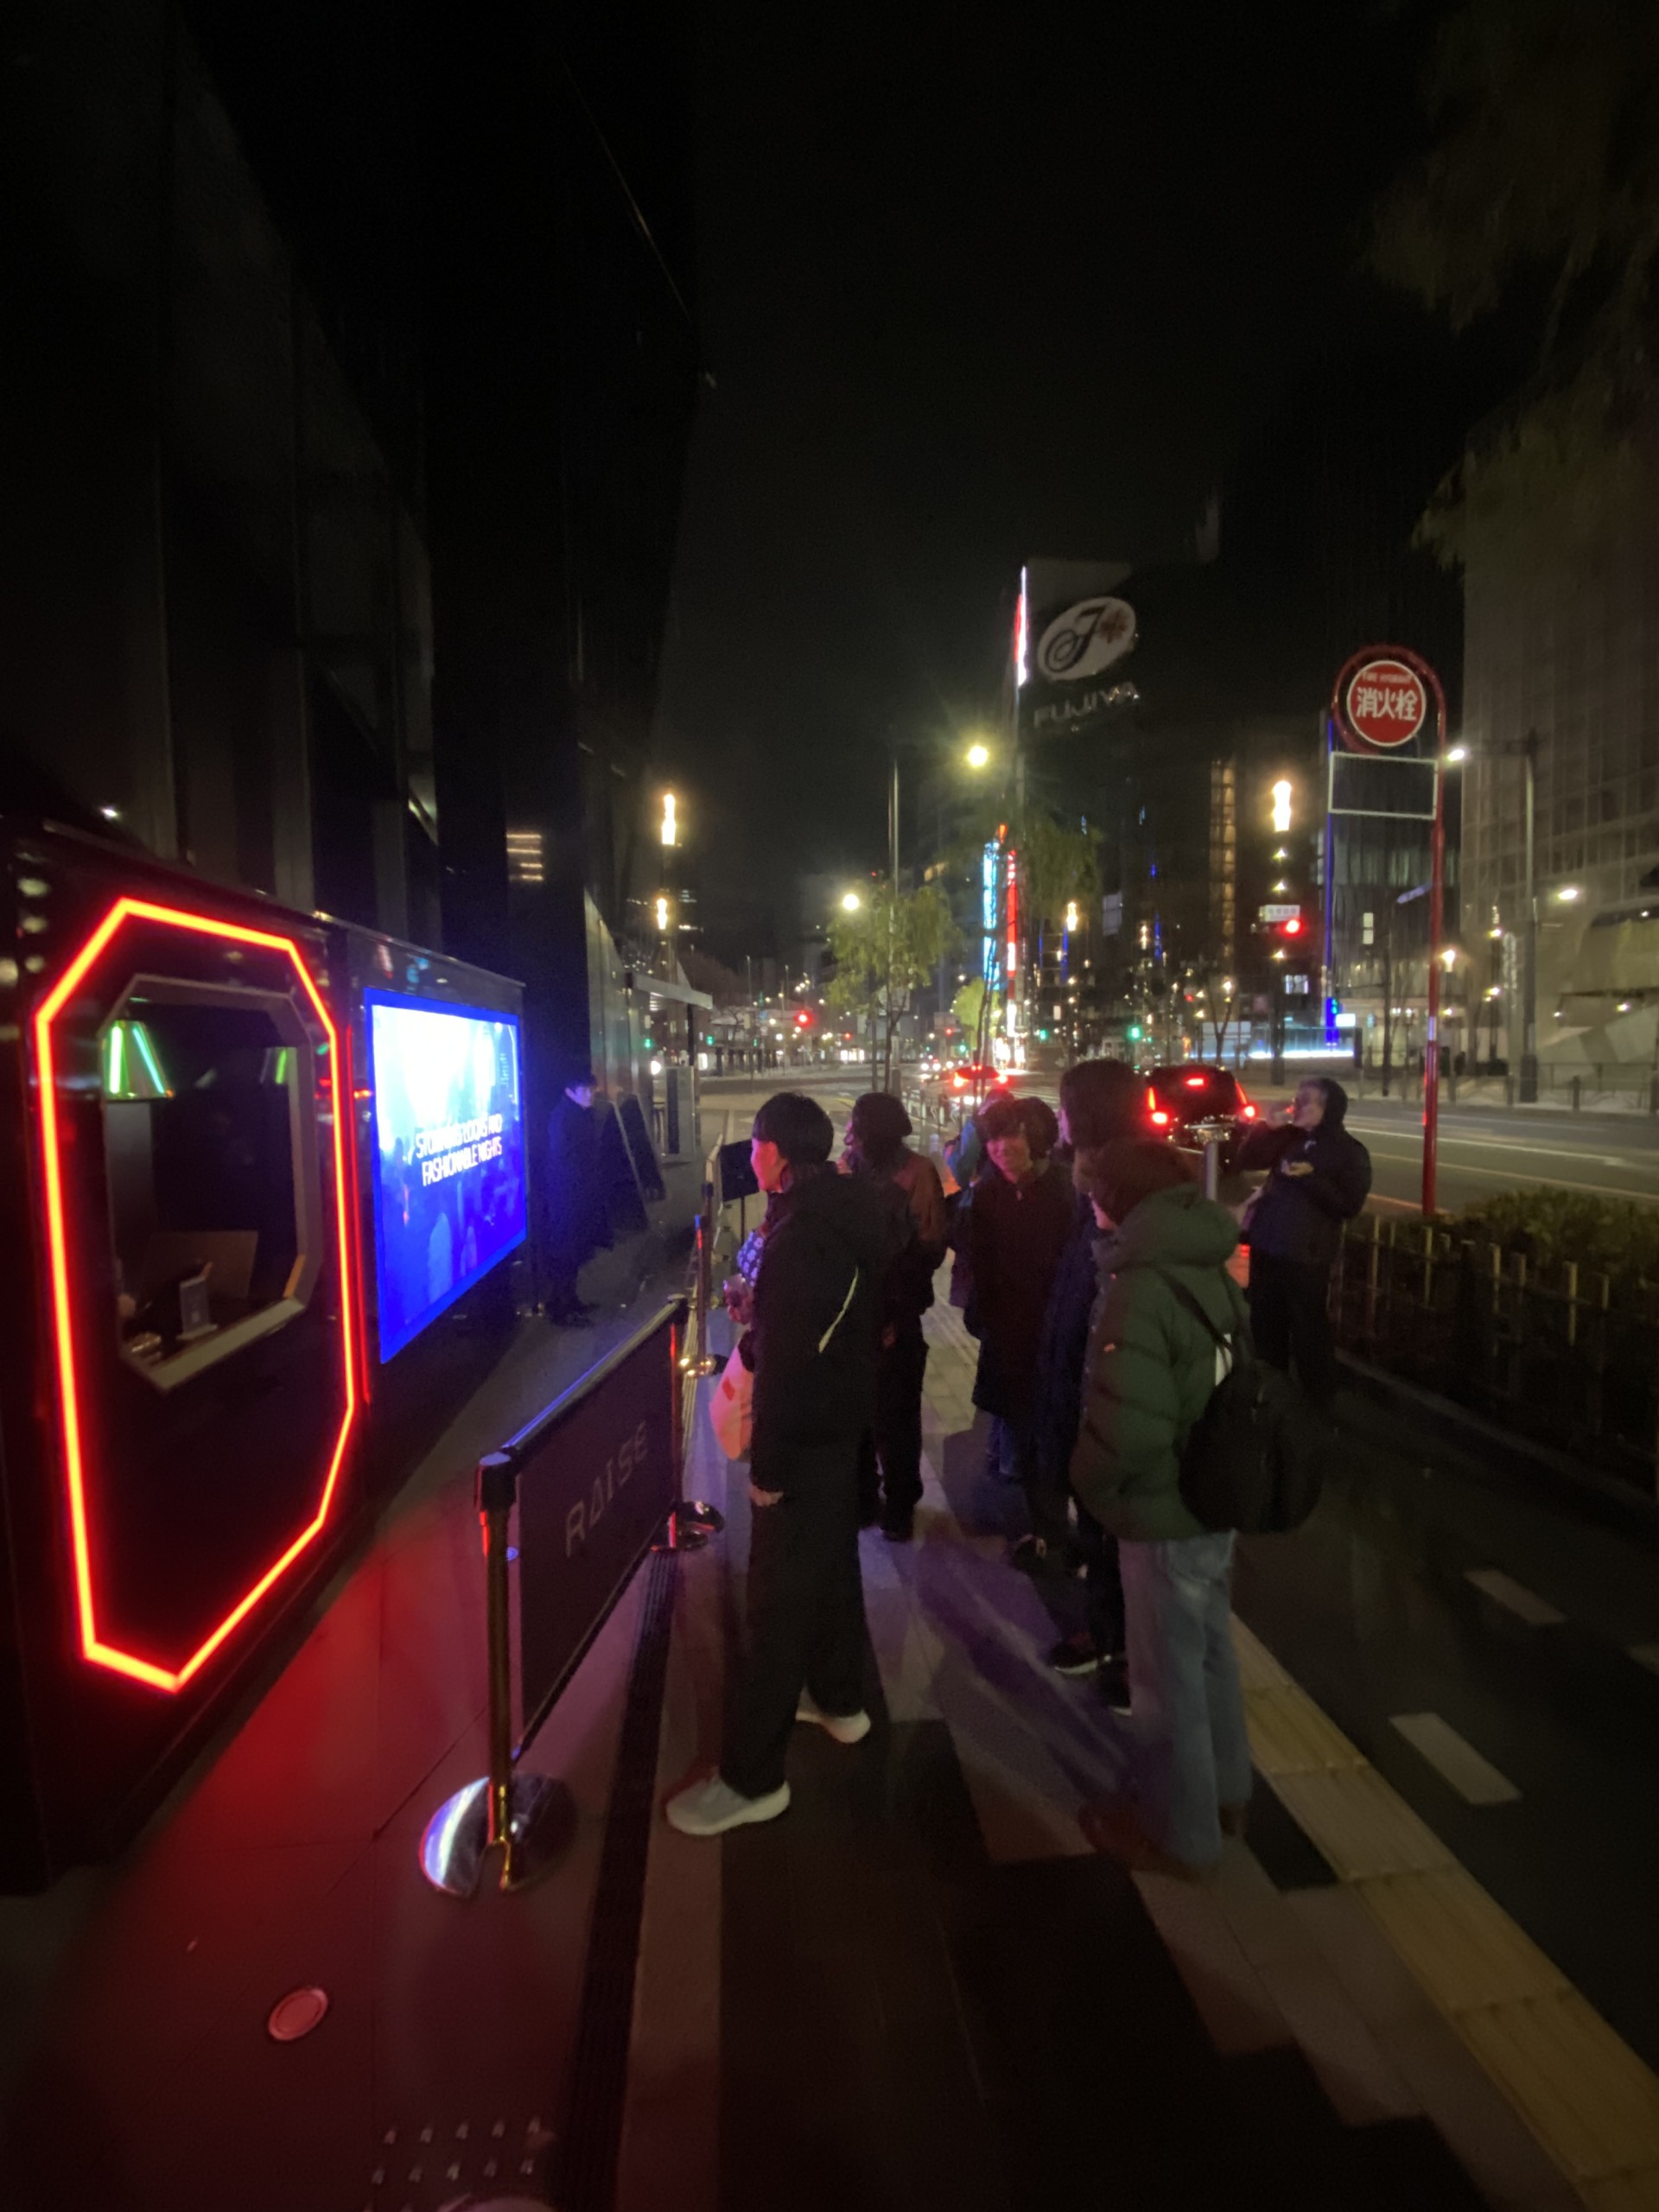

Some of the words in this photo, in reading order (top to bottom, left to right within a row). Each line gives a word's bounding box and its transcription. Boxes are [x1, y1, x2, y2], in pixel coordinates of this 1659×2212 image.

[1356, 686, 1417, 721] 消火栓
[565, 1420, 649, 1558] RAISE
